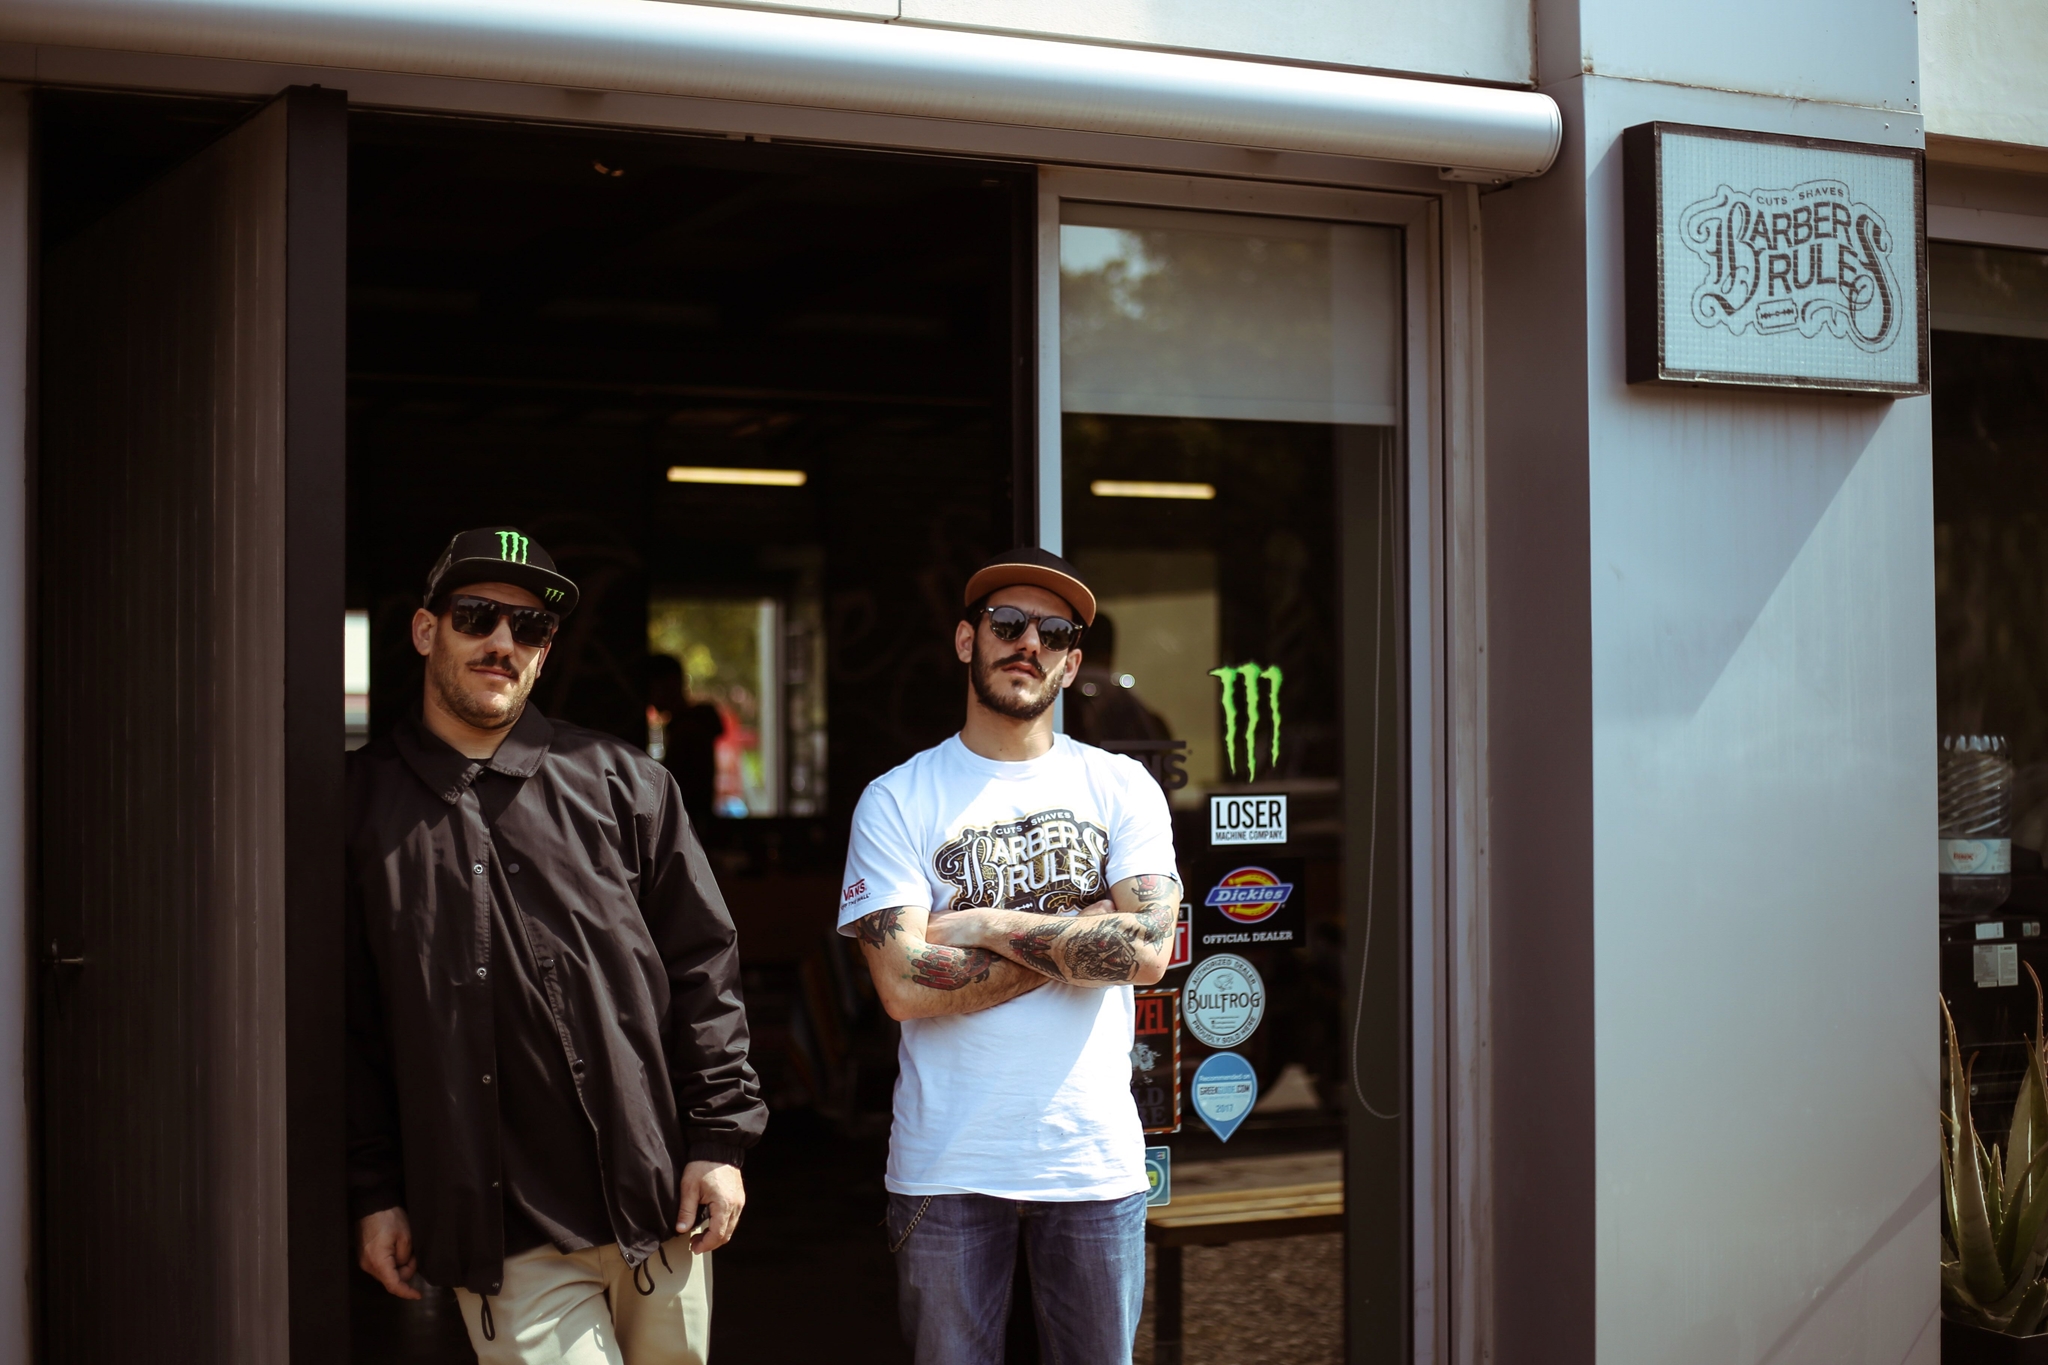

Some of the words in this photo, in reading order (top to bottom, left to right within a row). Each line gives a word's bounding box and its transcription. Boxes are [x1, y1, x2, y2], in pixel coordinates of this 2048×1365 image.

[1756, 195, 1788, 206] CUTS
[1798, 187, 1845, 201] SHAVES
[995, 825, 1023, 836] CUTS
[1030, 811, 1072, 826] SHAVES
[1215, 800, 1282, 829] LOSER
[1215, 831, 1247, 841] MACHINE
[843, 878, 866, 901] VANS
[1214, 888, 1284, 902] Dickies
[1202, 933, 1251, 944] OFFICIAL
[1252, 931, 1293, 942] DEALER
[1192, 959, 1233, 986] AUTHORIZED
[1234, 961, 1256, 985] DEALER
[1192, 1020, 1220, 1043] PROUDLY
[1222, 1034, 1241, 1044] SOLD
[1241, 1016, 1257, 1035] HERE
[1215, 1103, 1234, 1113] 2017
